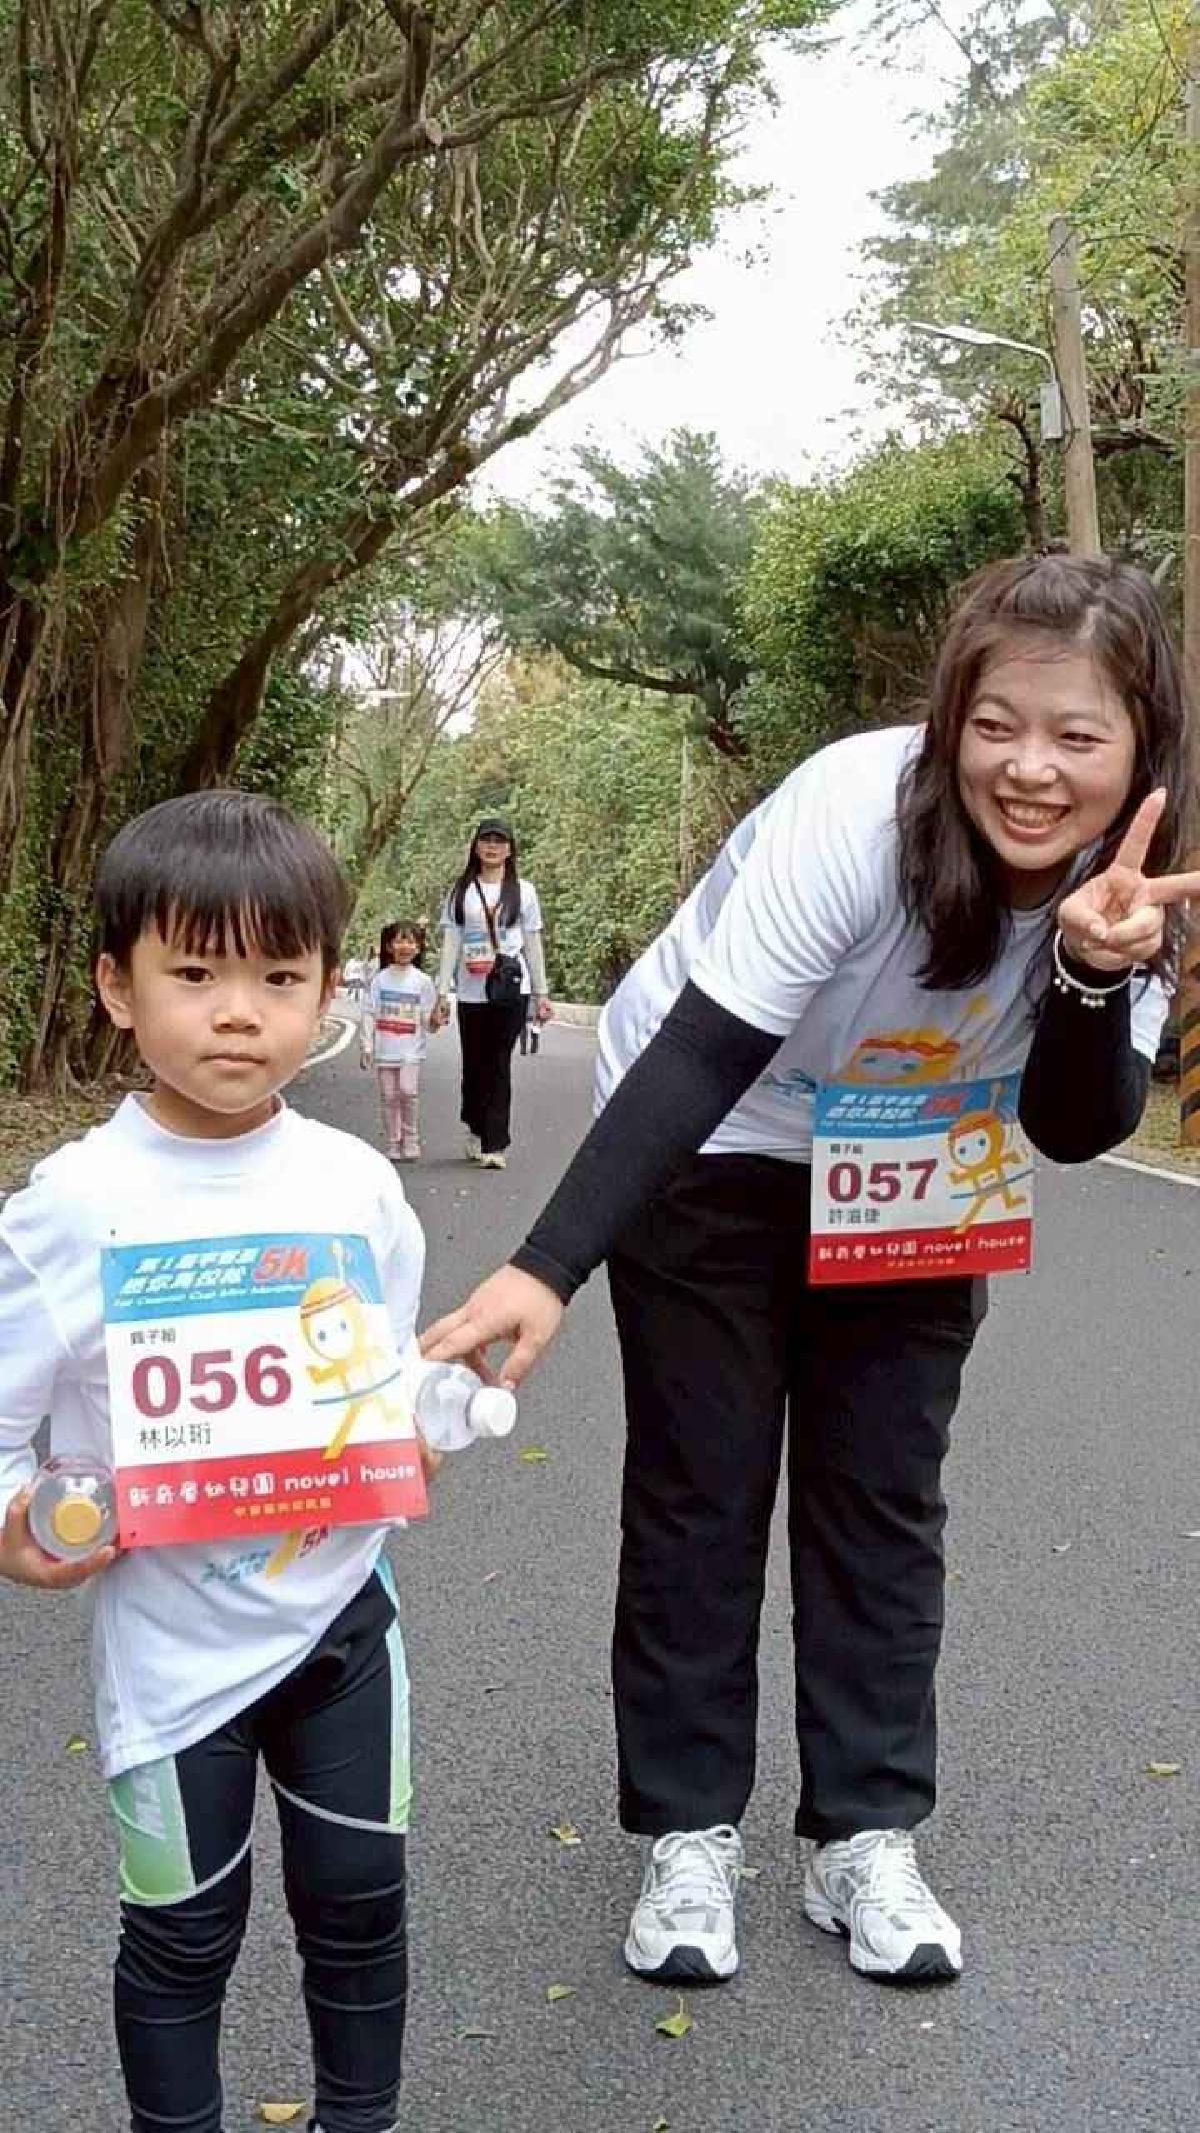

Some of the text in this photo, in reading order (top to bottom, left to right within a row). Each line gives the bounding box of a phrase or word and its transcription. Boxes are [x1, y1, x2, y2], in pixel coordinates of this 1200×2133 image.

[827, 1158, 939, 1204] 057
[253, 1245, 308, 1282] 5K
[923, 1238, 971, 1254] novel
[132, 1343, 293, 1419] 056
[284, 1468, 350, 1492] novel
[360, 1464, 417, 1484] house
